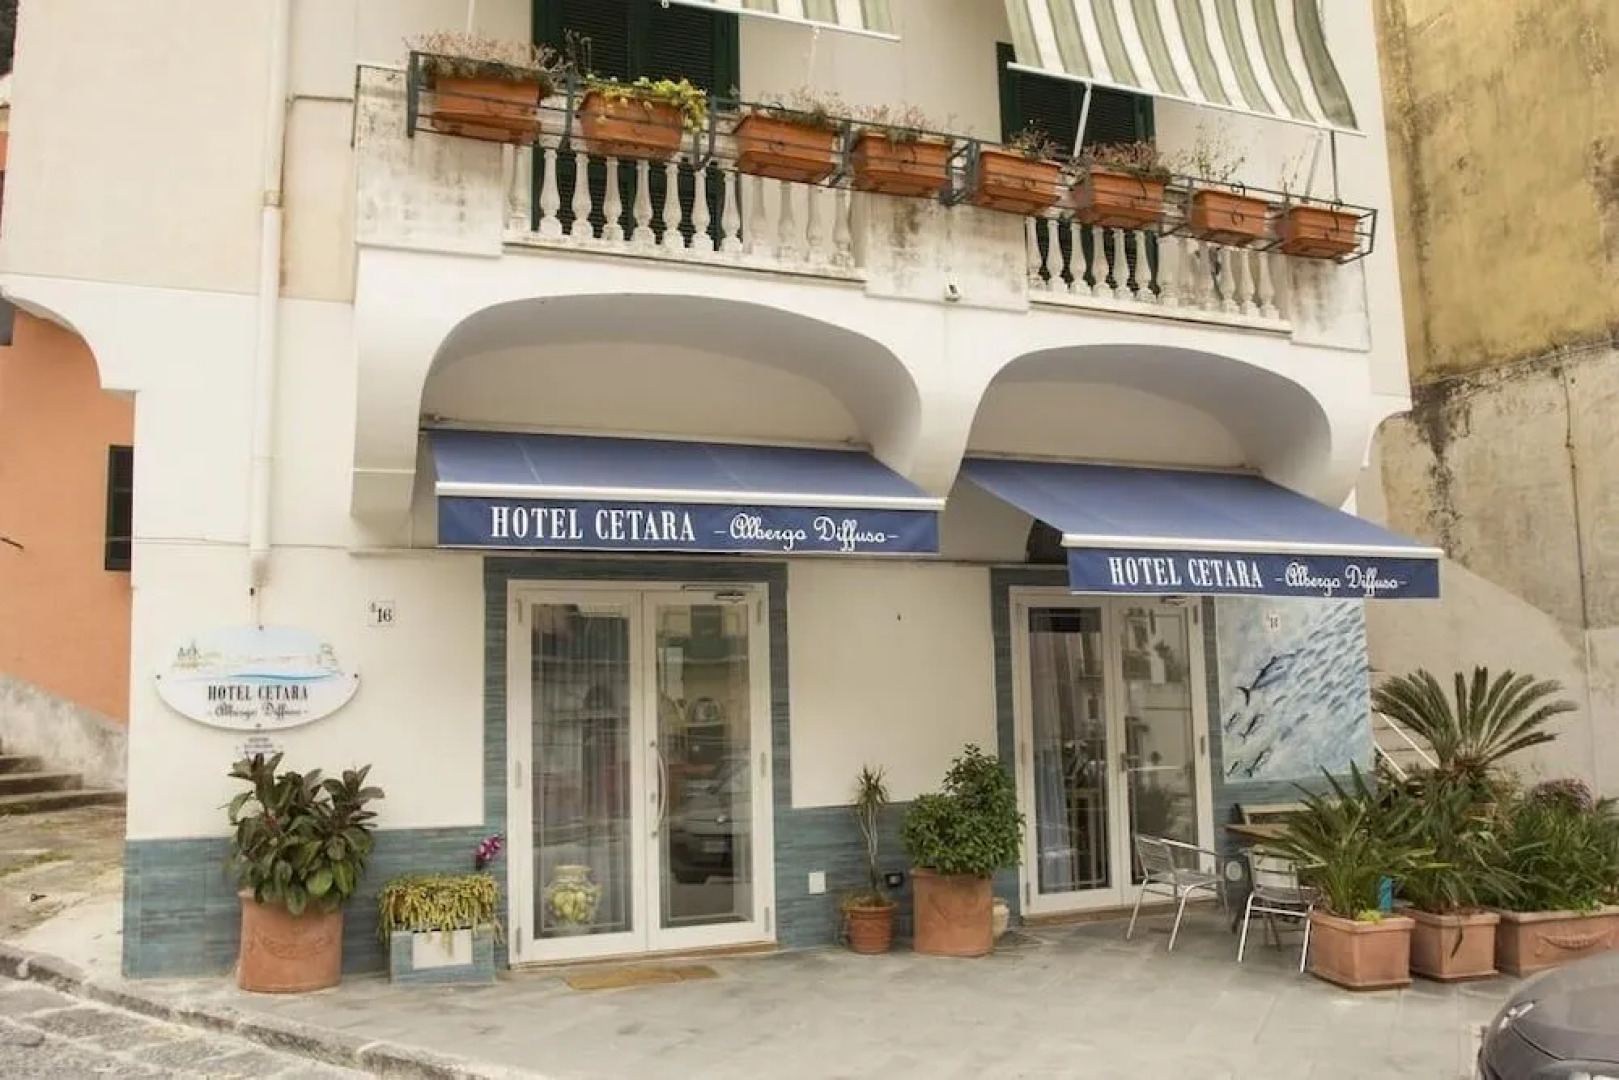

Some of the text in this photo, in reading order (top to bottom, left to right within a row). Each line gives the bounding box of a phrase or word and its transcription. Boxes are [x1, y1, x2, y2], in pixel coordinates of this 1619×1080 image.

[491, 506, 583, 540] HOTEL
[595, 509, 696, 542] CETARA
[1108, 556, 1182, 586] HOTEL
[1187, 558, 1264, 588] CETARA
[208, 685, 308, 700] HOTEL CETARA
